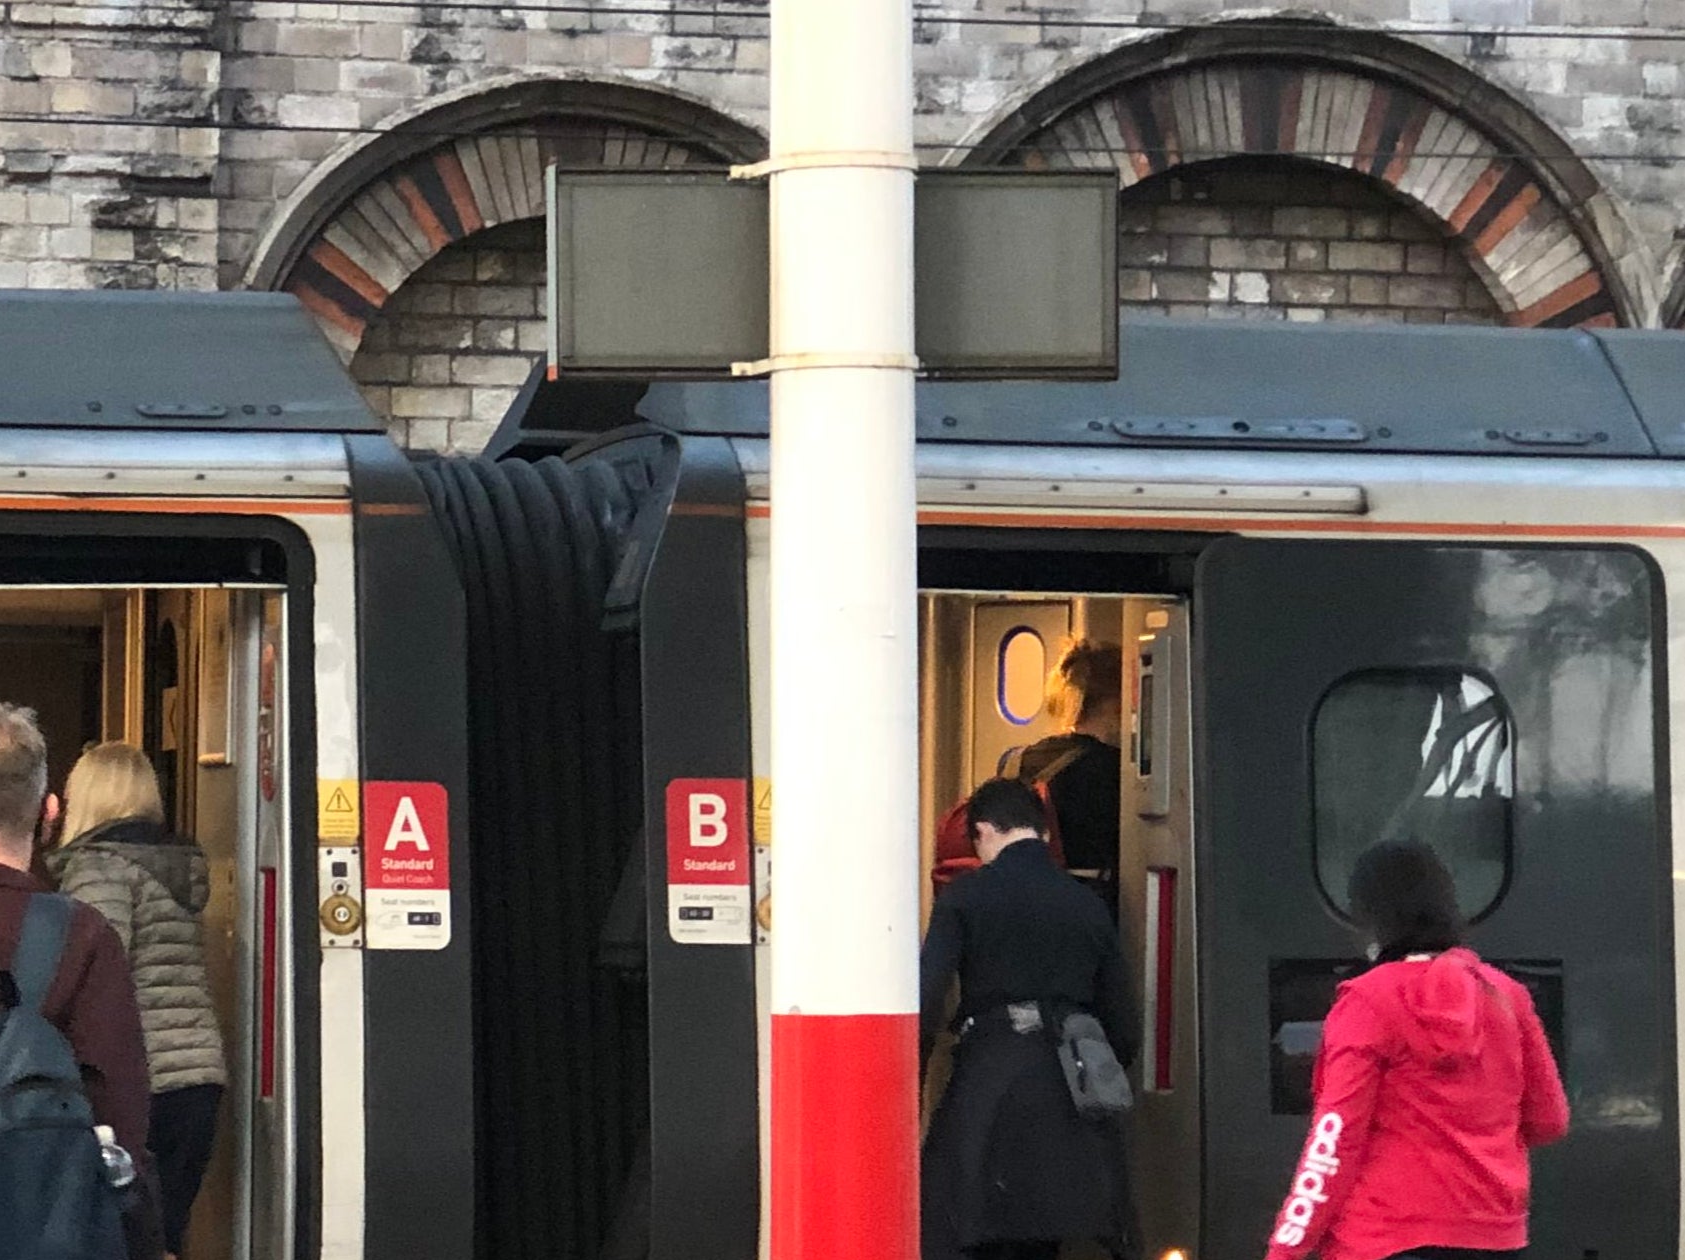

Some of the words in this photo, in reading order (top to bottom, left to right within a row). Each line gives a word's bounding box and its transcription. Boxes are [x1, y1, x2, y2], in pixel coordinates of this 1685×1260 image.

[384, 796, 430, 851] A
[688, 793, 728, 847] B
[381, 857, 434, 871] Standard
[683, 858, 736, 871] Standard
[1275, 1112, 1344, 1247] adidas
